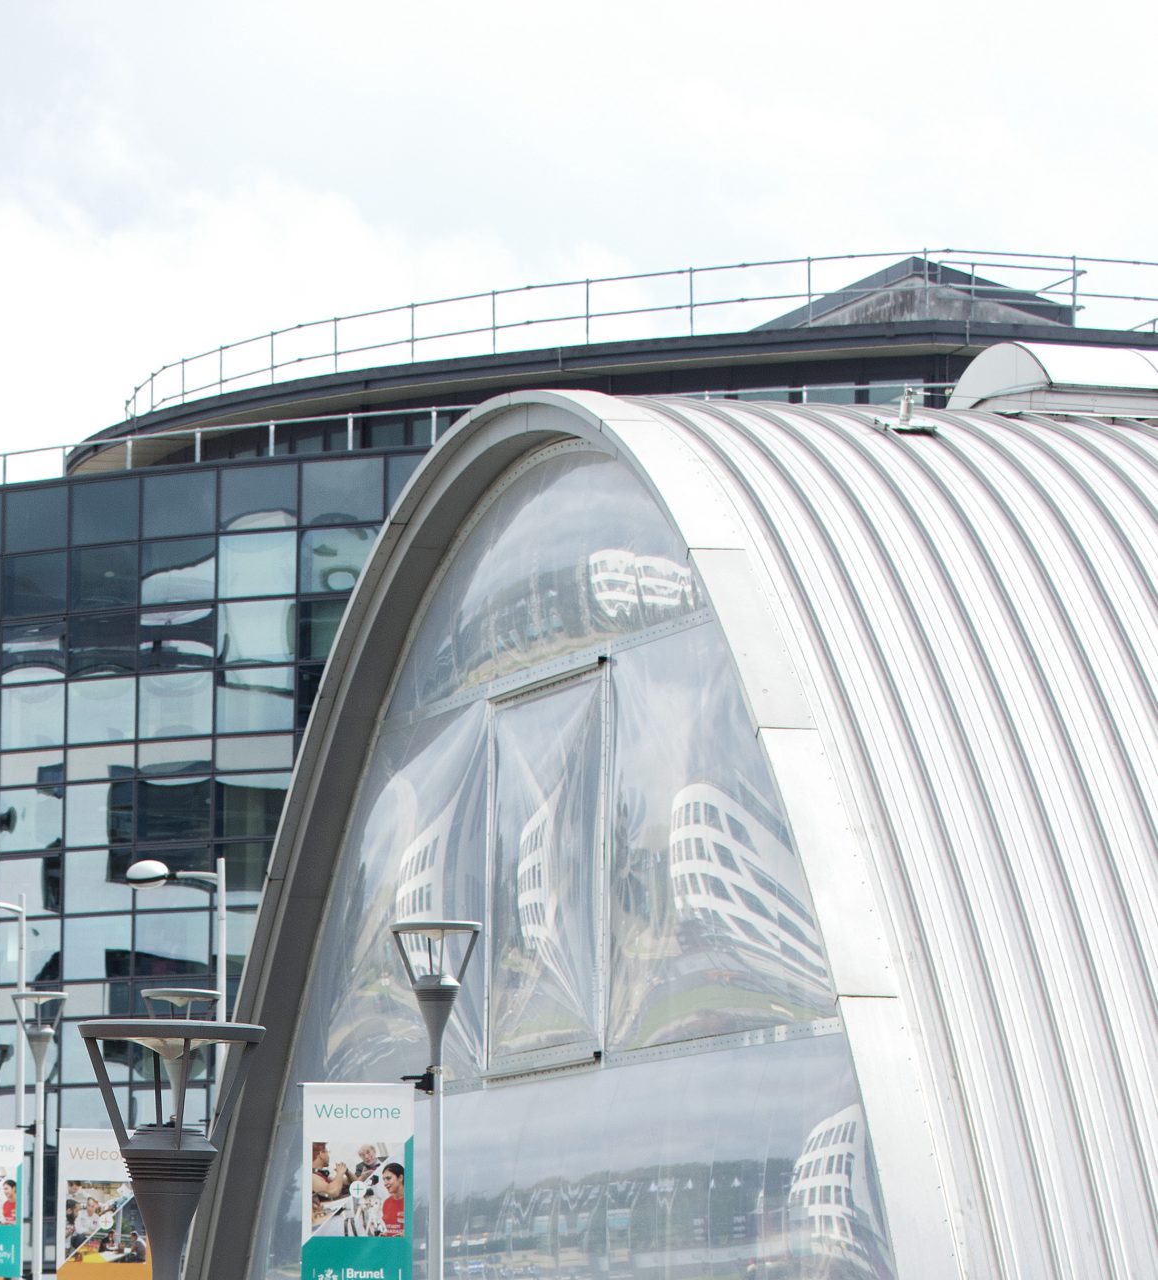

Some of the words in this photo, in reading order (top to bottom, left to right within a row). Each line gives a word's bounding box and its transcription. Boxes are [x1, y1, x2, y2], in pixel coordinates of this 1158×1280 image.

[314, 1103, 401, 1119] Welcome
[69, 1147, 124, 1161] Welco
[346, 1268, 384, 1279] Brunel
